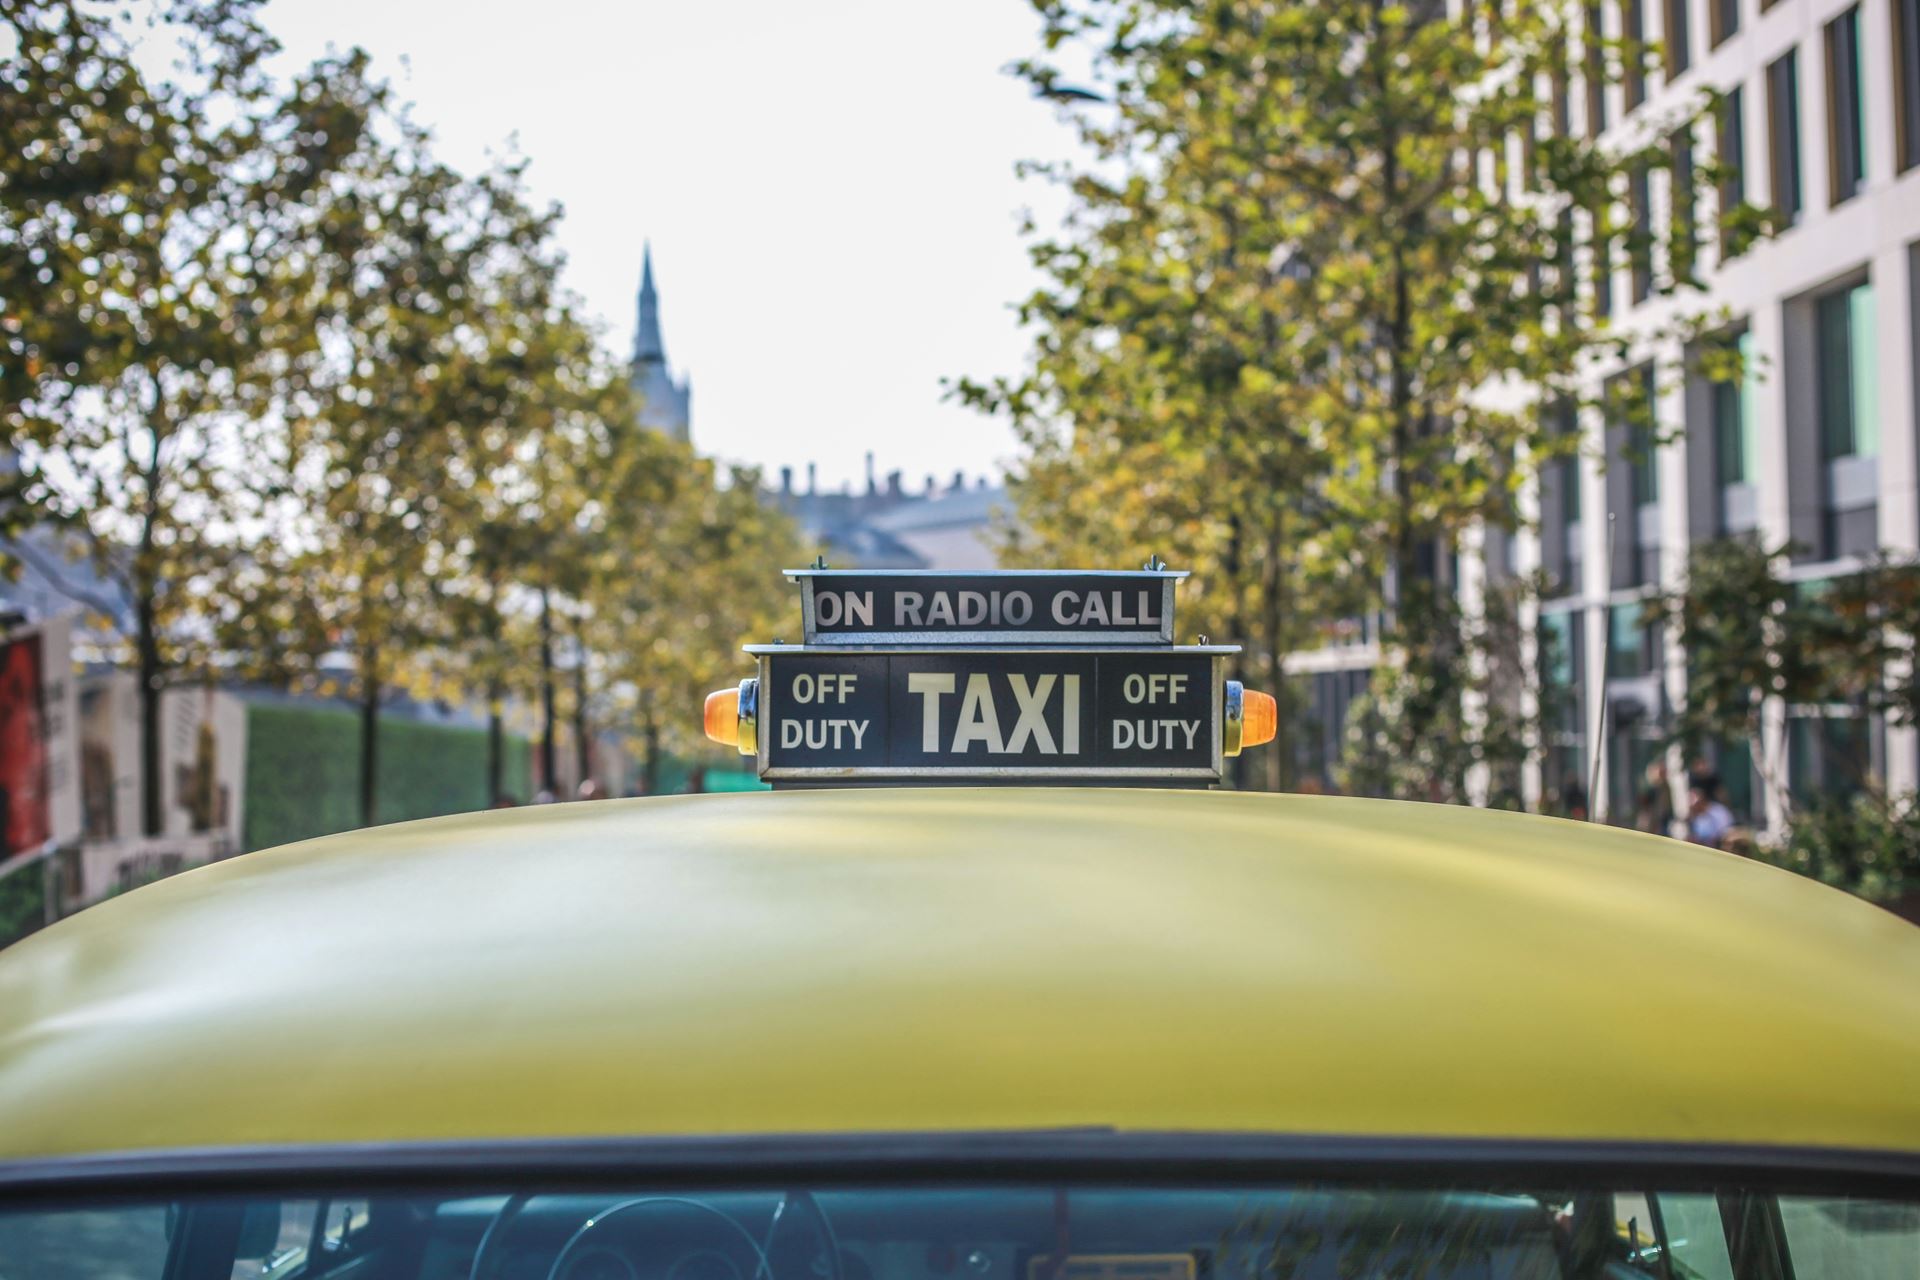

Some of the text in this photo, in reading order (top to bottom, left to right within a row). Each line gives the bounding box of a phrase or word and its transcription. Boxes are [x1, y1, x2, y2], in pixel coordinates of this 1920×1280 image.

[815, 590, 1161, 627] ON RADIO CALL
[792, 673, 858, 704] OFF
[1123, 673, 1189, 704] OFF
[908, 672, 1080, 755] TAXI
[780, 719, 870, 750] DUTY
[1112, 719, 1201, 750] DUTY
